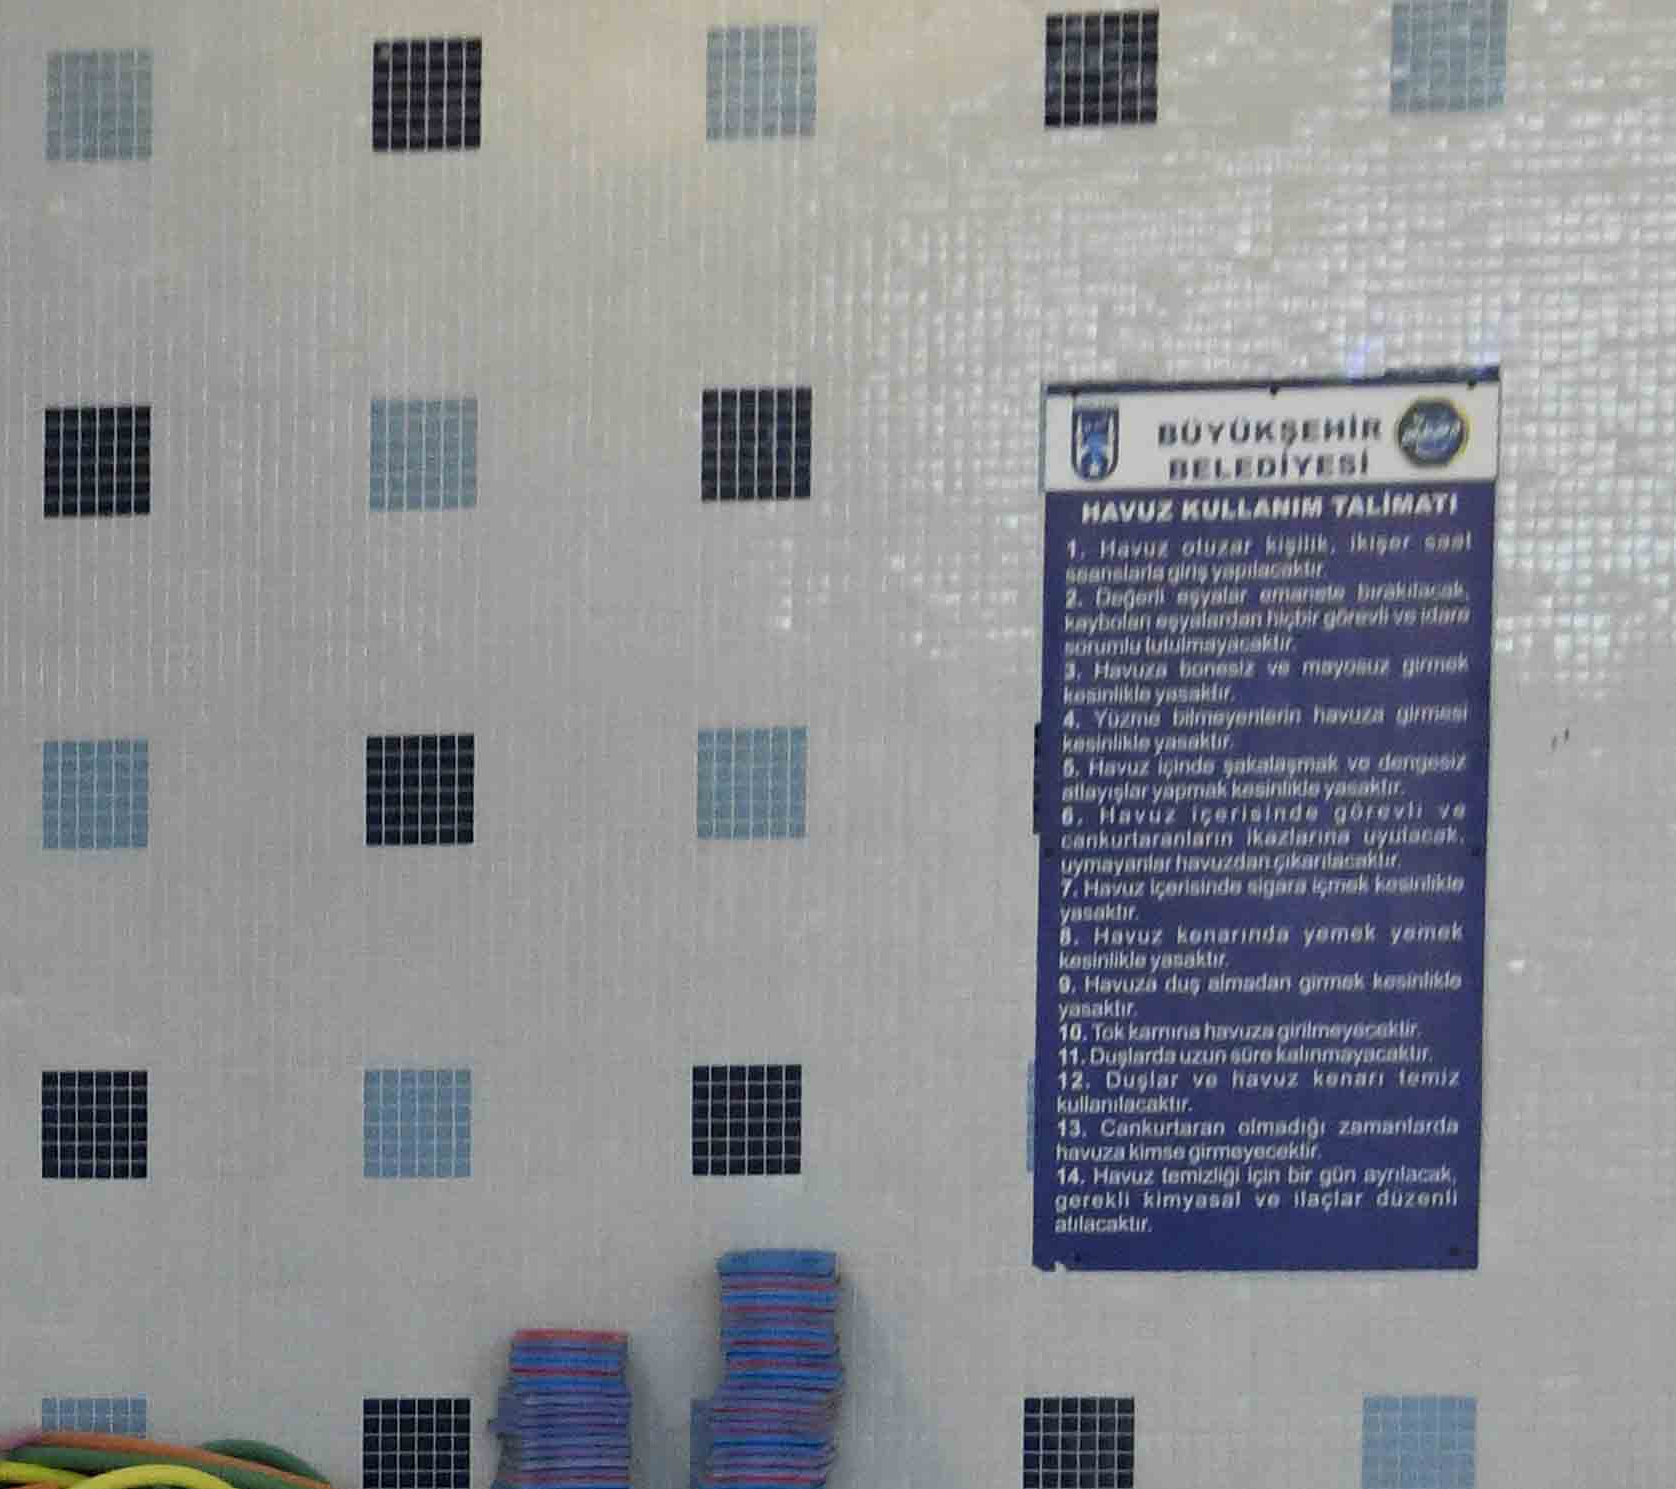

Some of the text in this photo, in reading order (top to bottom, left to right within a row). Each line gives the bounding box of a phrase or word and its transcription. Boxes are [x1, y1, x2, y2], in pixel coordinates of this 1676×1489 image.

[1158, 413, 1382, 447] BÜYÜKŞEHİR
[1168, 448, 1369, 481] BELEDİYESİ
[1082, 490, 1458, 525] HAVUZ KULLANIM TALİMATI
[1067, 538, 1085, 560] 1.
[1101, 537, 1169, 559] Havuz
[1066, 588, 1082, 608] 2.
[1394, 608, 1417, 625] ve
[1065, 638, 1141, 656] sorumlu
[1065, 661, 1081, 680] 3.
[1095, 661, 1167, 680] Havuza
[1267, 660, 1290, 677] ve
[1064, 683, 1235, 706] kesinlikle yasaktır.
[1063, 709, 1080, 728] 4.
[1095, 708, 1161, 728] Yüzme
[1173, 705, 1301, 728] bilmeyenlerin
[1314, 704, 1385, 724] havuza
[1063, 732, 1234, 756] kesinlikle yasaktır.
[1089, 757, 1148, 776] Havuz
[1223, 752, 1338, 778] şakalaşmak
[1348, 756, 1370, 772] ve
[1152, 780, 1226, 803] yapmak
[1232, 778, 1320, 798] kesinlikle
[1324, 776, 1405, 800] yasaktır.
[1061, 801, 1465, 828] 6. Havuz içerisinde görevli ve
[1061, 829, 1232, 848] cankurtaranların
[1061, 854, 1171, 878] uymayanlar
[1176, 853, 1270, 873] havuzdan
[1061, 873, 1465, 901] 7. Havuz içerisinde sigara içmek kesinlikle
[1060, 904, 1139, 926] yasaktır.
[1059, 920, 1463, 947] 8. Havuz kenarında yemek yemek
[1059, 950, 1230, 973] kesinlikle yasaktır.
[1059, 970, 1462, 996] 9. Havuza duş almadan girmek kesinlikle
[1058, 1000, 1138, 1023] yasaktır.
[1059, 1018, 1422, 1043] 10. Tok karnına havuza girilmeyecektir.
[1058, 1043, 1433, 1069] 11. Duşlarda uzun süre kalınmayacaktır.
[1058, 1068, 1459, 1092] 12. Duşlar ve havuz kenarı temiz
[1057, 1095, 1193, 1115] kullanılacaktır.
[1057, 1115, 1459, 1139] 13. Cankurtaran olmadığı zamanlarda
[1057, 1140, 1322, 1164] havuza kimse girmeyecektir.
[1057, 1161, 1456, 1188] 14. Havuz temizliği için bir gün ayrılacak,
[1055, 1188, 1458, 1212] gerekli kimyasal ve ilaçlar düzenli
[1055, 1214, 1152, 1234] atılacaktır.
